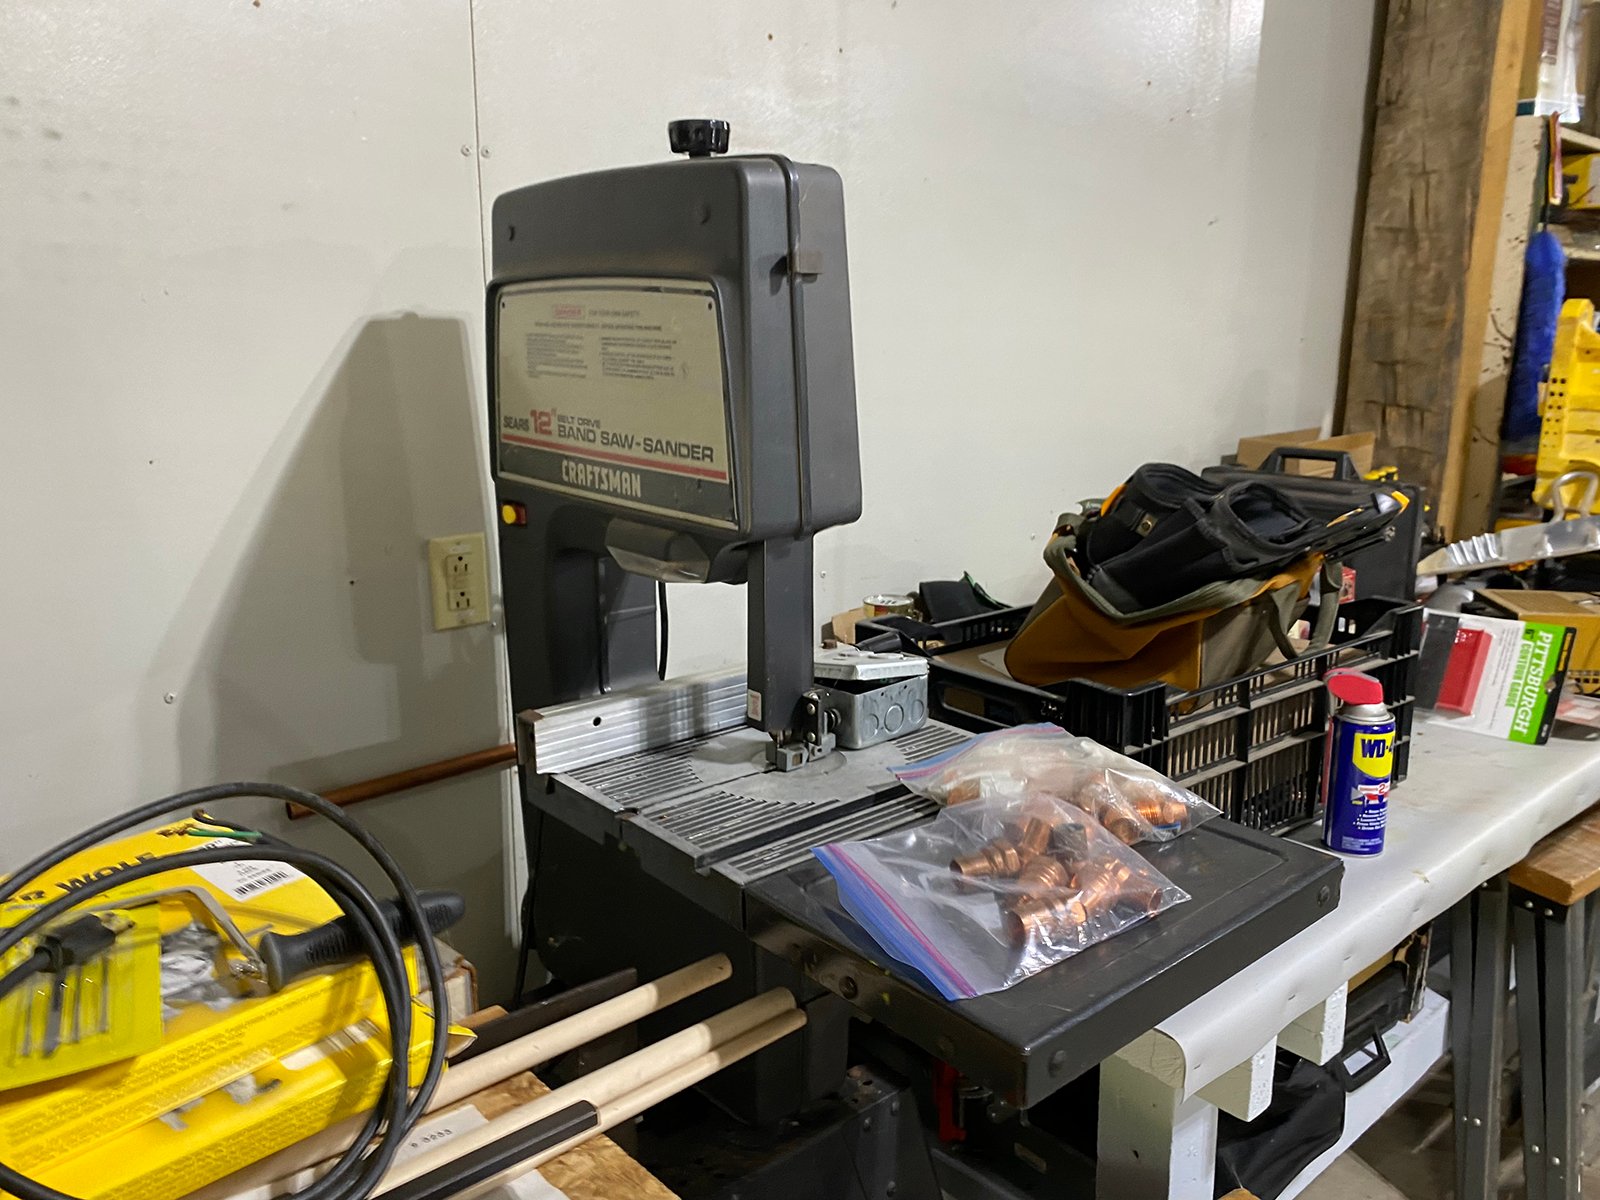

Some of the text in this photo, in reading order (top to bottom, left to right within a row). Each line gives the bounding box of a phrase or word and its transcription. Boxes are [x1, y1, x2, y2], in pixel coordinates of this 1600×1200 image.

[503, 415, 530, 432] SEARS
[557, 414, 601, 430] BELT DRIVE
[558, 424, 597, 443] BAND
[561, 459, 642, 498] CRAFTSMAN
[1513, 630, 1554, 735] PITTSBURGH
